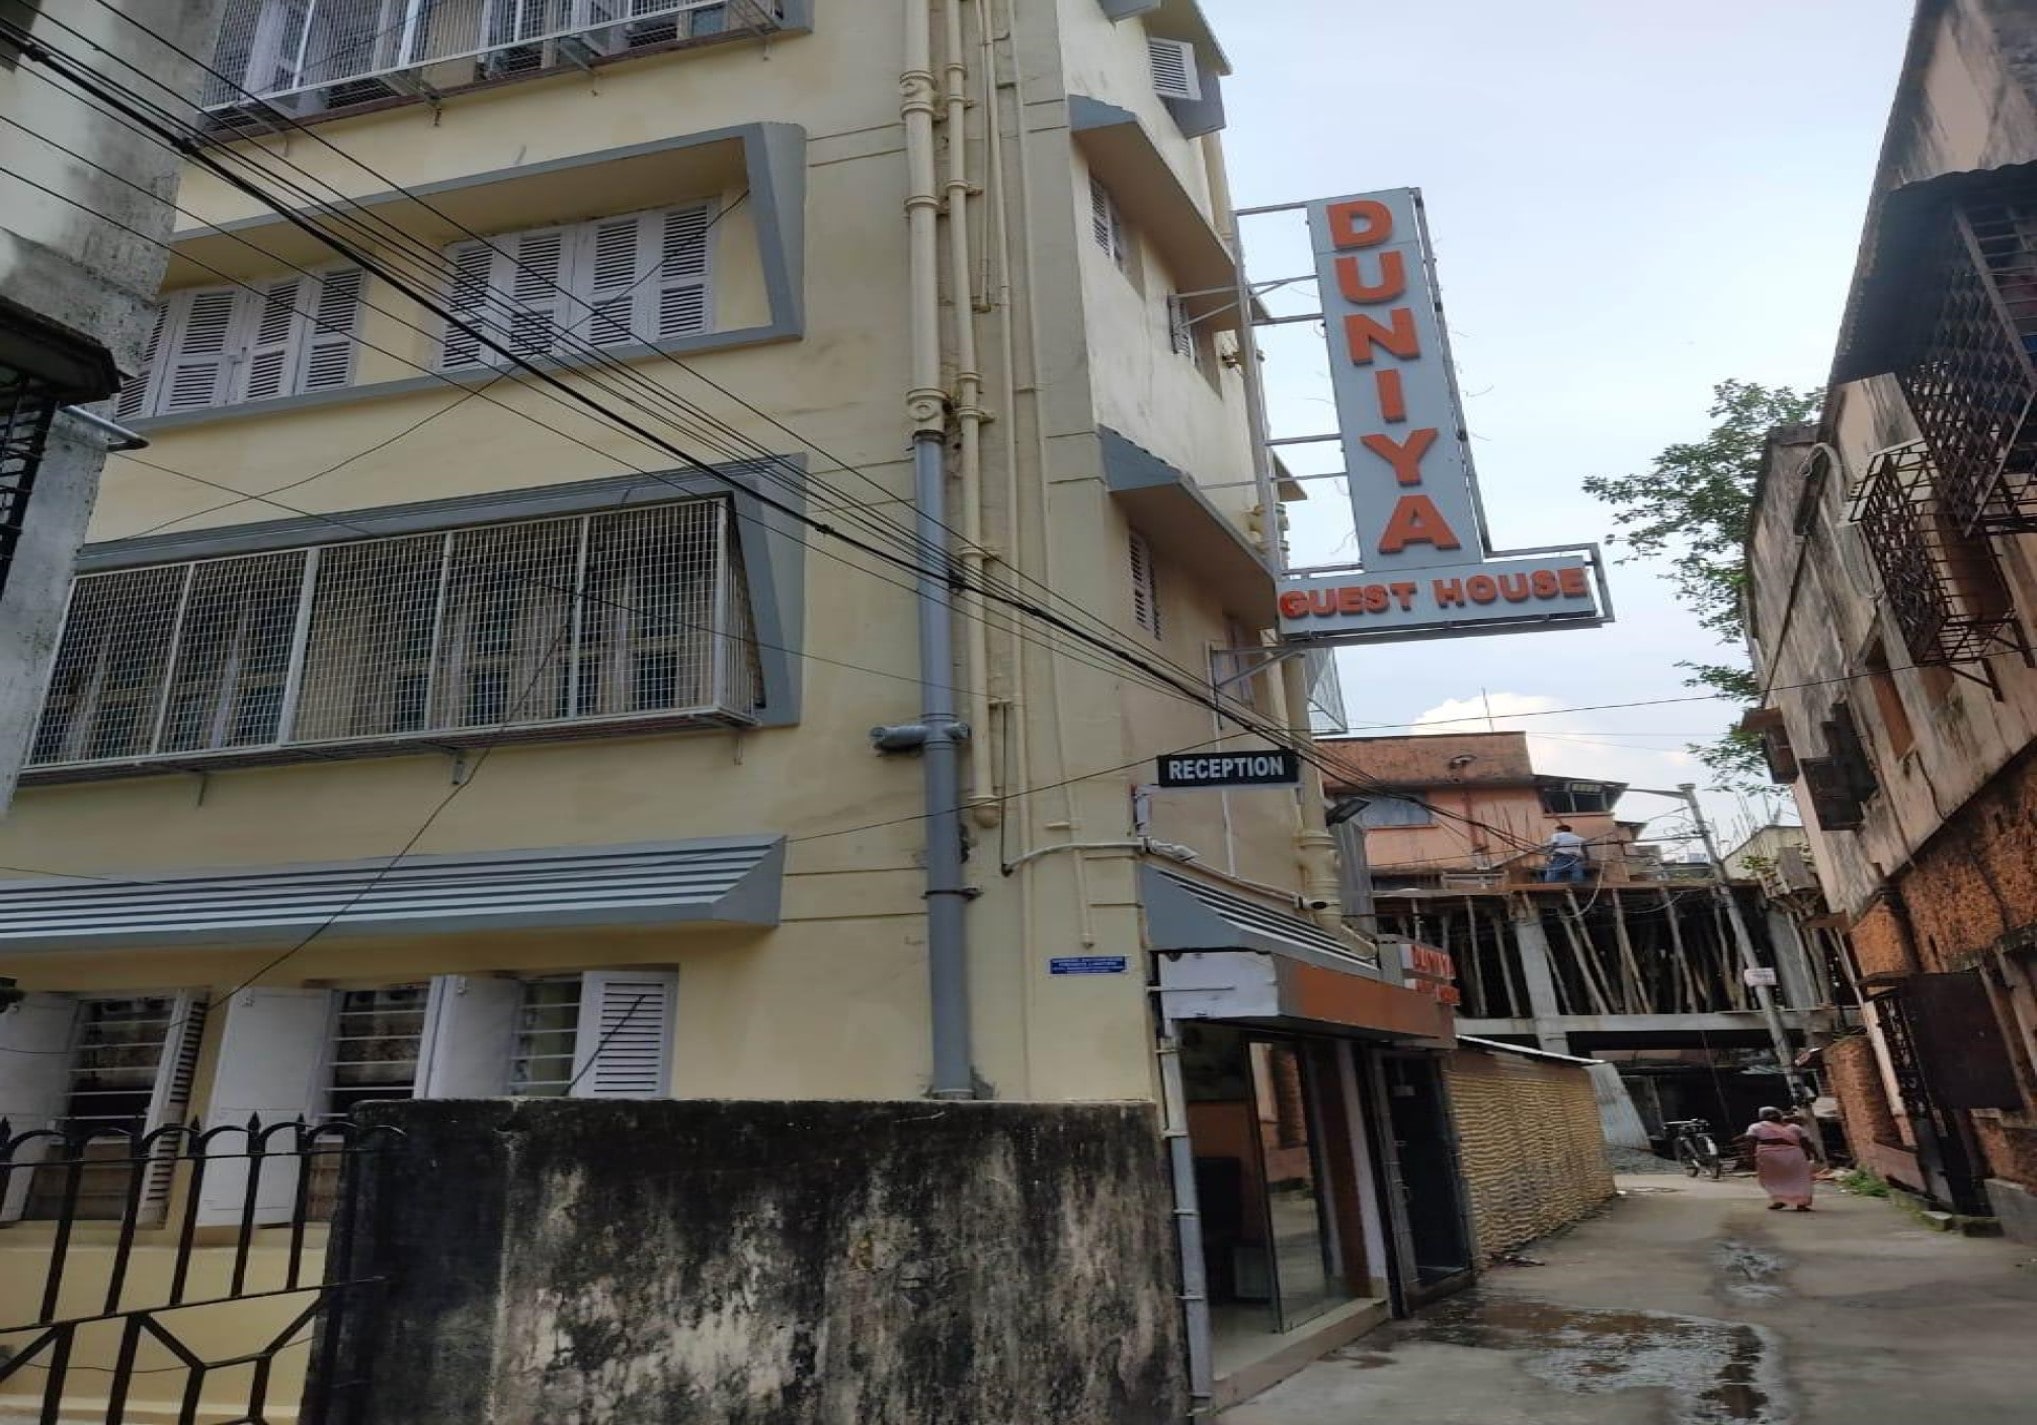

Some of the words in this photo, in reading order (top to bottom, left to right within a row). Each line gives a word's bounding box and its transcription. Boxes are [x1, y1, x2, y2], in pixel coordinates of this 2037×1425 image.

[1326, 199, 1461, 554] DUNIYA
[1280, 581, 1417, 620] GUEST
[1432, 567, 1588, 608] HOUSE
[1168, 756, 1285, 780] RECEPTION
